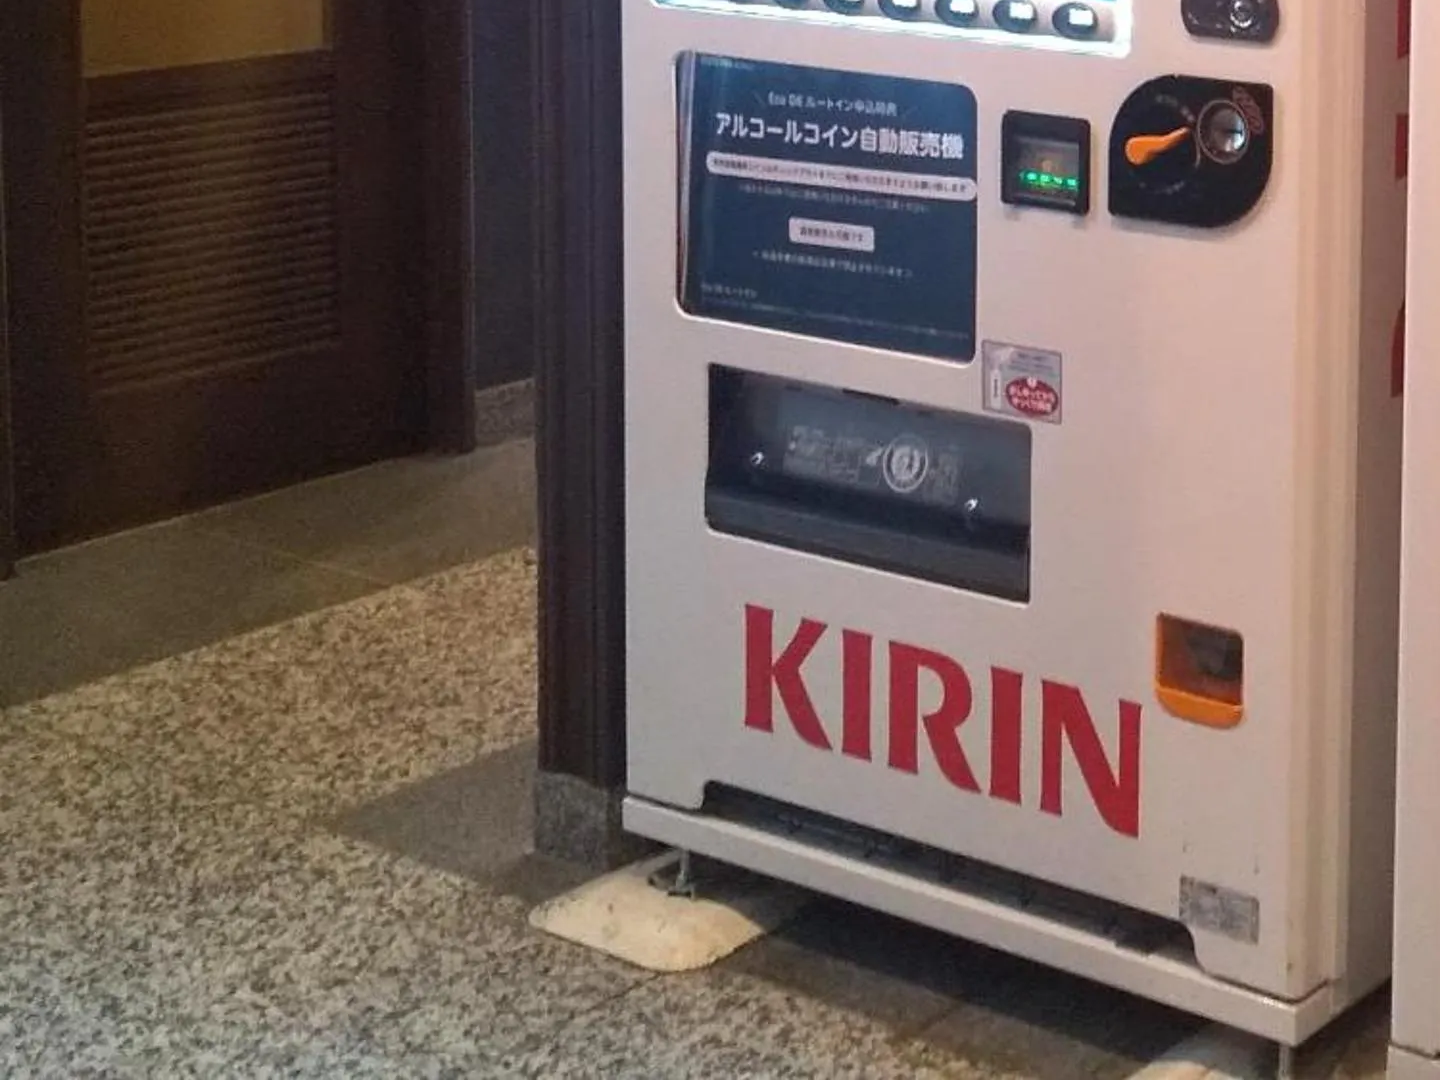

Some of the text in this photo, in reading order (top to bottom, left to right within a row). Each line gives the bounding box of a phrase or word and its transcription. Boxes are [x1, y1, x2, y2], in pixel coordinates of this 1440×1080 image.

[715, 112, 965, 159] アルコールコイン自動販売機
[744, 604, 1142, 839] KIRIN
